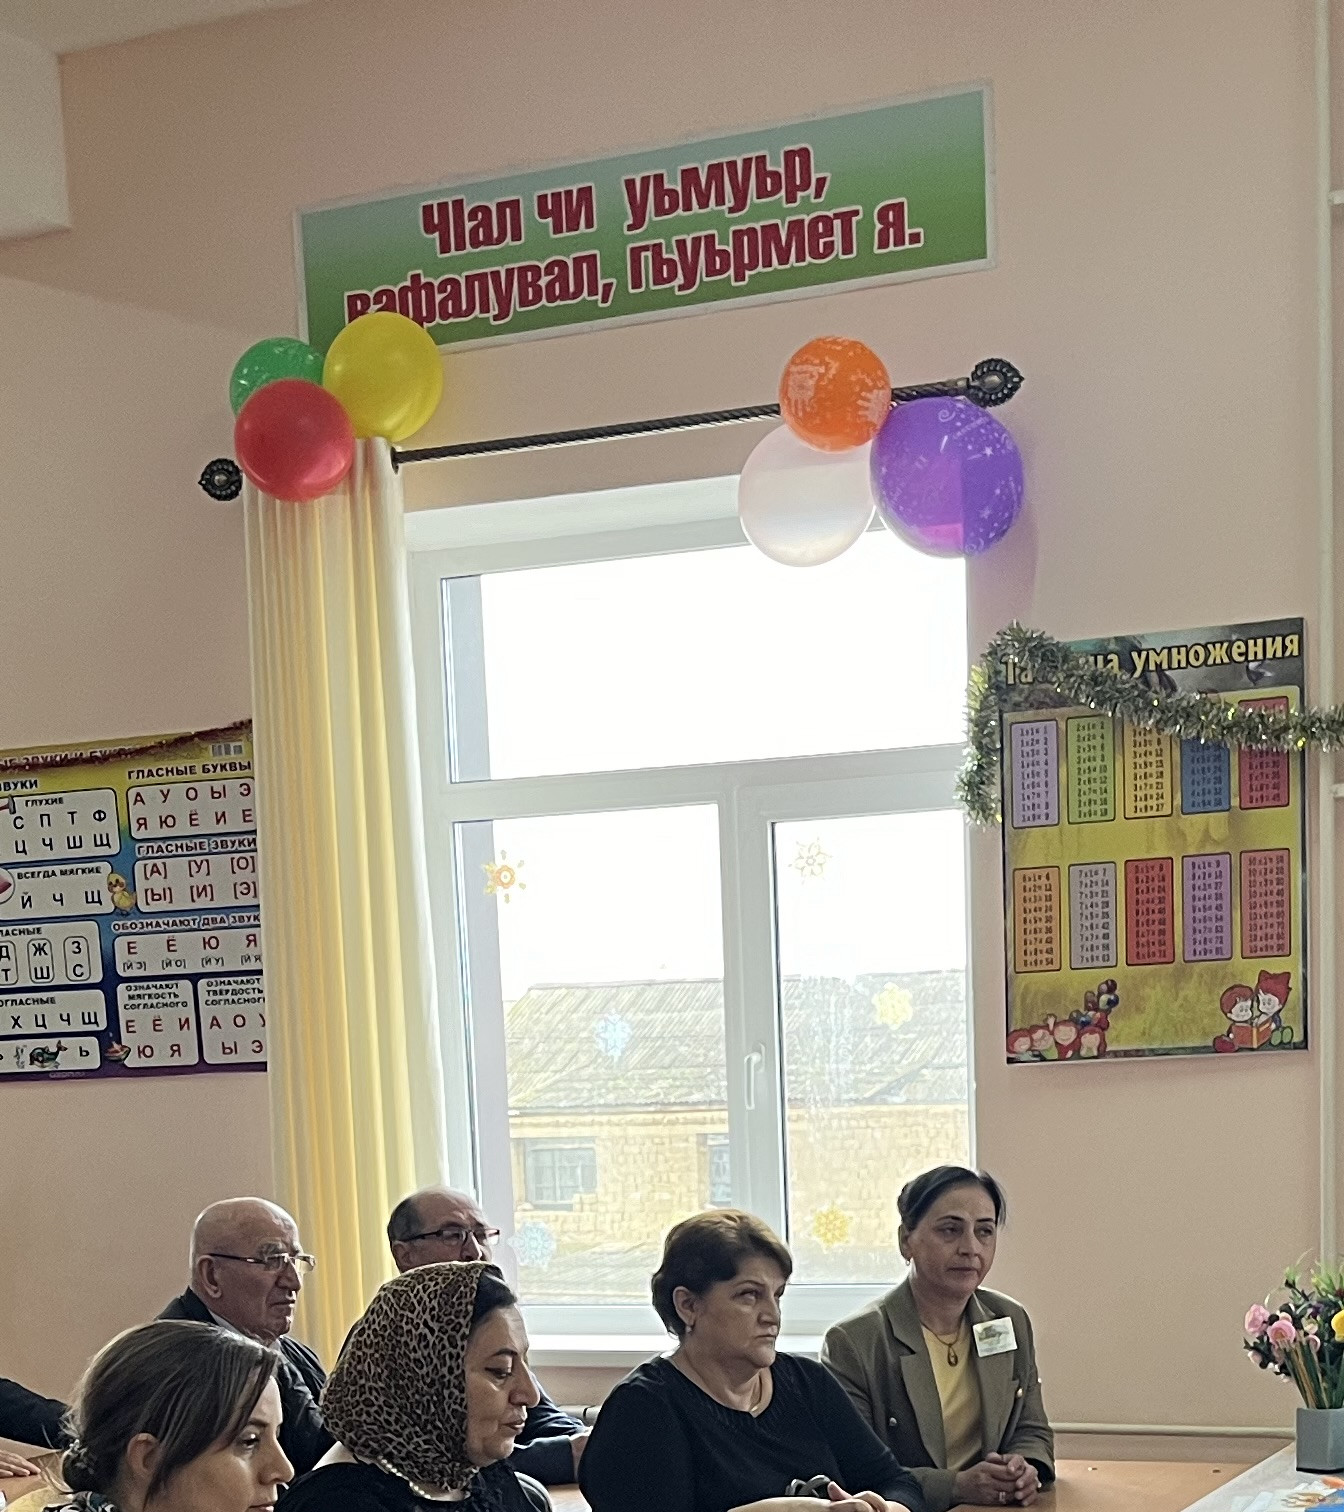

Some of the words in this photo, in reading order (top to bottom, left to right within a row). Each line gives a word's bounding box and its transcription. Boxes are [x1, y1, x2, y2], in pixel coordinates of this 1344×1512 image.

[537, 186, 595, 236] чи
[624, 146, 827, 231] уьмуьр,
[630, 208, 860, 288] гьуьрмет
[874, 200, 923, 251] я.
[1131, 633, 1299, 678] умножения
[127, 765, 197, 780] ГЛАСНЫЕ
[202, 761, 251, 774] БУКВЫ
[133, 792, 145, 805] А
[160, 789, 170, 803] У
[186, 787, 198, 801] О
[211, 785, 226, 799] Ы
[240, 783, 251, 796] Э
[13, 816, 24, 829] С
[40, 814, 51, 827] П
[67, 811, 77, 825] Т
[93, 810, 106, 822] Ф
[137, 817, 147, 831] Я
[159, 815, 176, 829] Ю
[189, 811, 199, 827] Ё
[215, 811, 226, 825] И
[242, 809, 253, 823] Е
[15, 840, 27, 855] Ц
[42, 838, 53, 851] Ч
[67, 835, 82, 849] Ш
[94, 833, 111, 848] Щ
[137, 841, 207, 855] ГЛАСНЫЕ
[17, 869, 57, 880] ВСЕГДА
[21, 892, 32, 909] Й
[53, 893, 63, 906] Ч
[85, 890, 102, 905] Щ
[113, 918, 198, 931] ОБОЗНАЧАЮТ
[202, 915, 226, 926] ДВА
[0, 945, 10, 961] Д
[32, 943, 48, 956] Ж
[72, 941, 81, 954] З
[127, 941, 137, 954] Е
[167, 935, 177, 952] Ё
[203, 936, 219, 950] Ю
[246, 934, 257, 948] Я
[1, 969, 11, 981] Т
[34, 966, 50, 979] Ш
[73, 964, 84, 977] С
[124, 1001, 188, 1010] СОГЛАСНОГО
[11, 1016, 22, 1029] Х
[35, 1014, 47, 1029] Ц
[60, 1013, 70, 1026] Ч
[82, 1012, 99, 1027] Щ
[126, 1020, 136, 1033] Е
[153, 1016, 163, 1032] Ё
[179, 1018, 190, 1031] И
[210, 1016, 221, 1029] А
[234, 1015, 245, 1027] О
[79, 1046, 90, 1057] Ь
[138, 1045, 153, 1058] Ю
[170, 1044, 181, 1057] Я
[222, 1041, 237, 1055] Ы
[252, 1040, 263, 1053] Э
